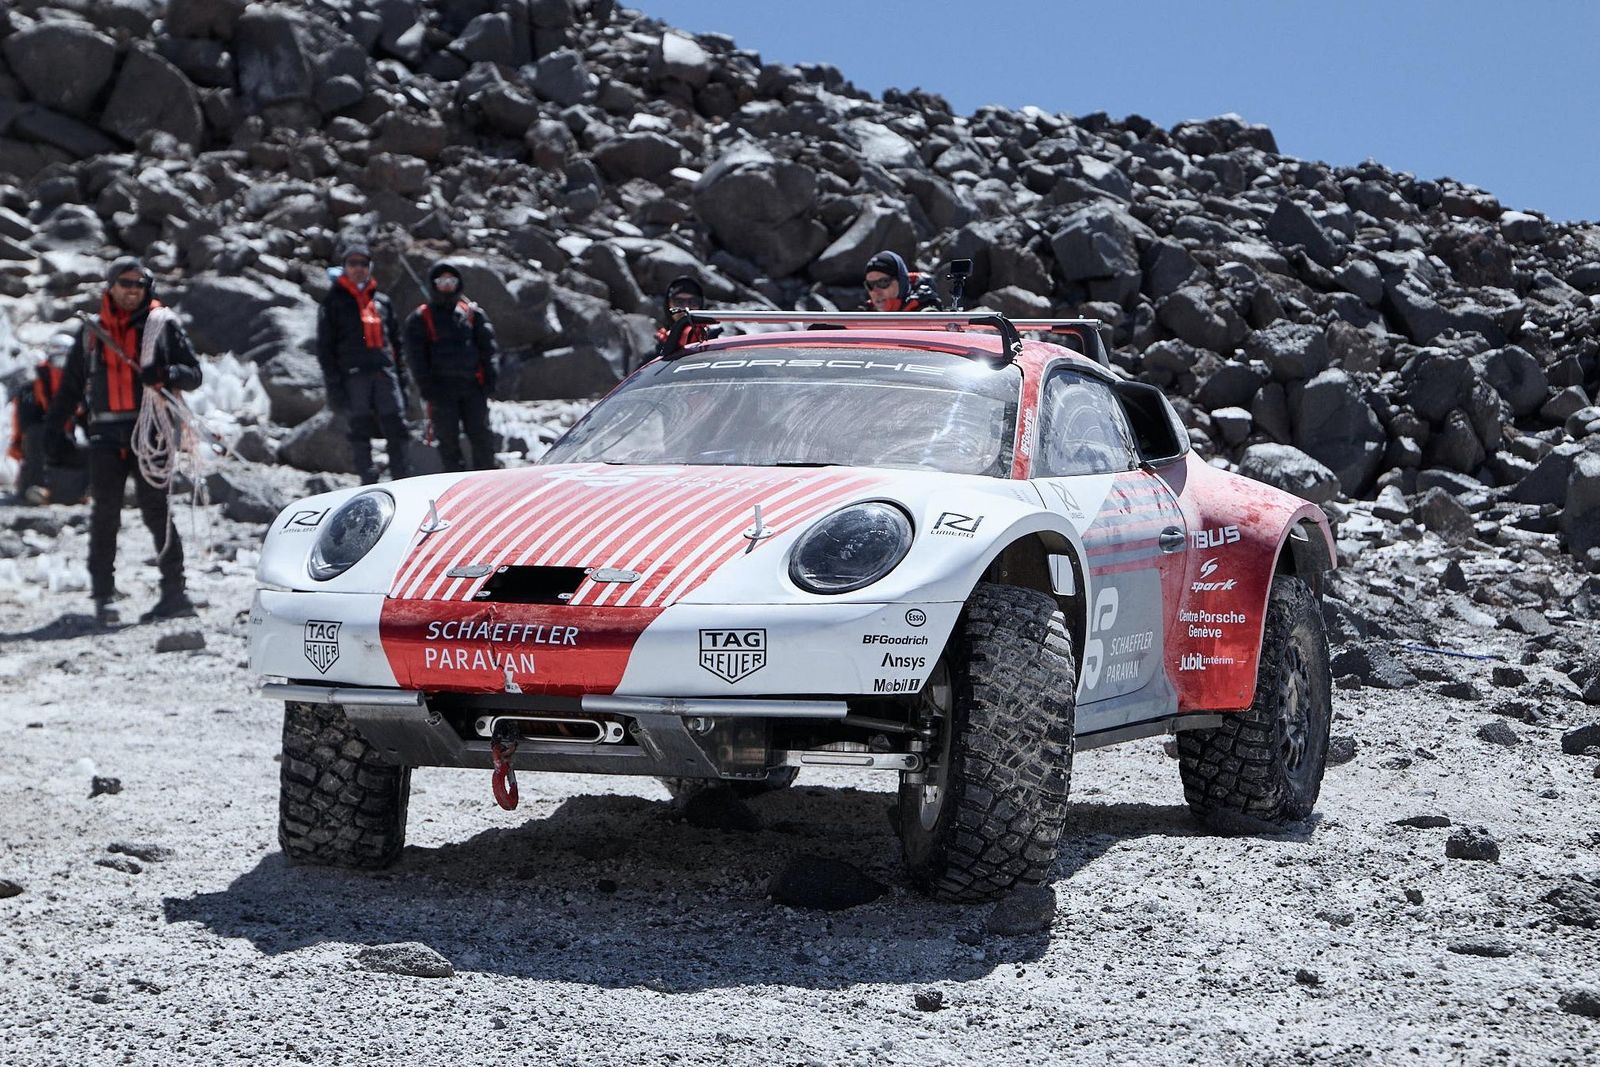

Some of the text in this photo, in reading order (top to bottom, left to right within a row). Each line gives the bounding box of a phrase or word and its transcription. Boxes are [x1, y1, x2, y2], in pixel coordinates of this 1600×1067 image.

[673, 359, 946, 376] PORSCHE
[1020, 407, 1033, 456] BFGoodrich
[1191, 579, 1238, 593] spark
[908, 613, 924, 622] Esso
[1179, 609, 1246, 623] Centre Porsche
[308, 623, 337, 639] TAG
[426, 621, 579, 646] SCHAEFFLER
[705, 632, 760, 647] TAG
[1188, 624, 1222, 638] Genève
[862, 635, 928, 645] BFGoodrich
[1110, 631, 1154, 656] SCHAEFFLER
[306, 644, 337, 669] HEUER
[425, 647, 536, 674] PARAVAN
[881, 652, 926, 671] Ansys
[704, 653, 762, 679] HEUER
[1106, 660, 1139, 683] PARAVAN
[874, 678, 908, 692] Mobil
